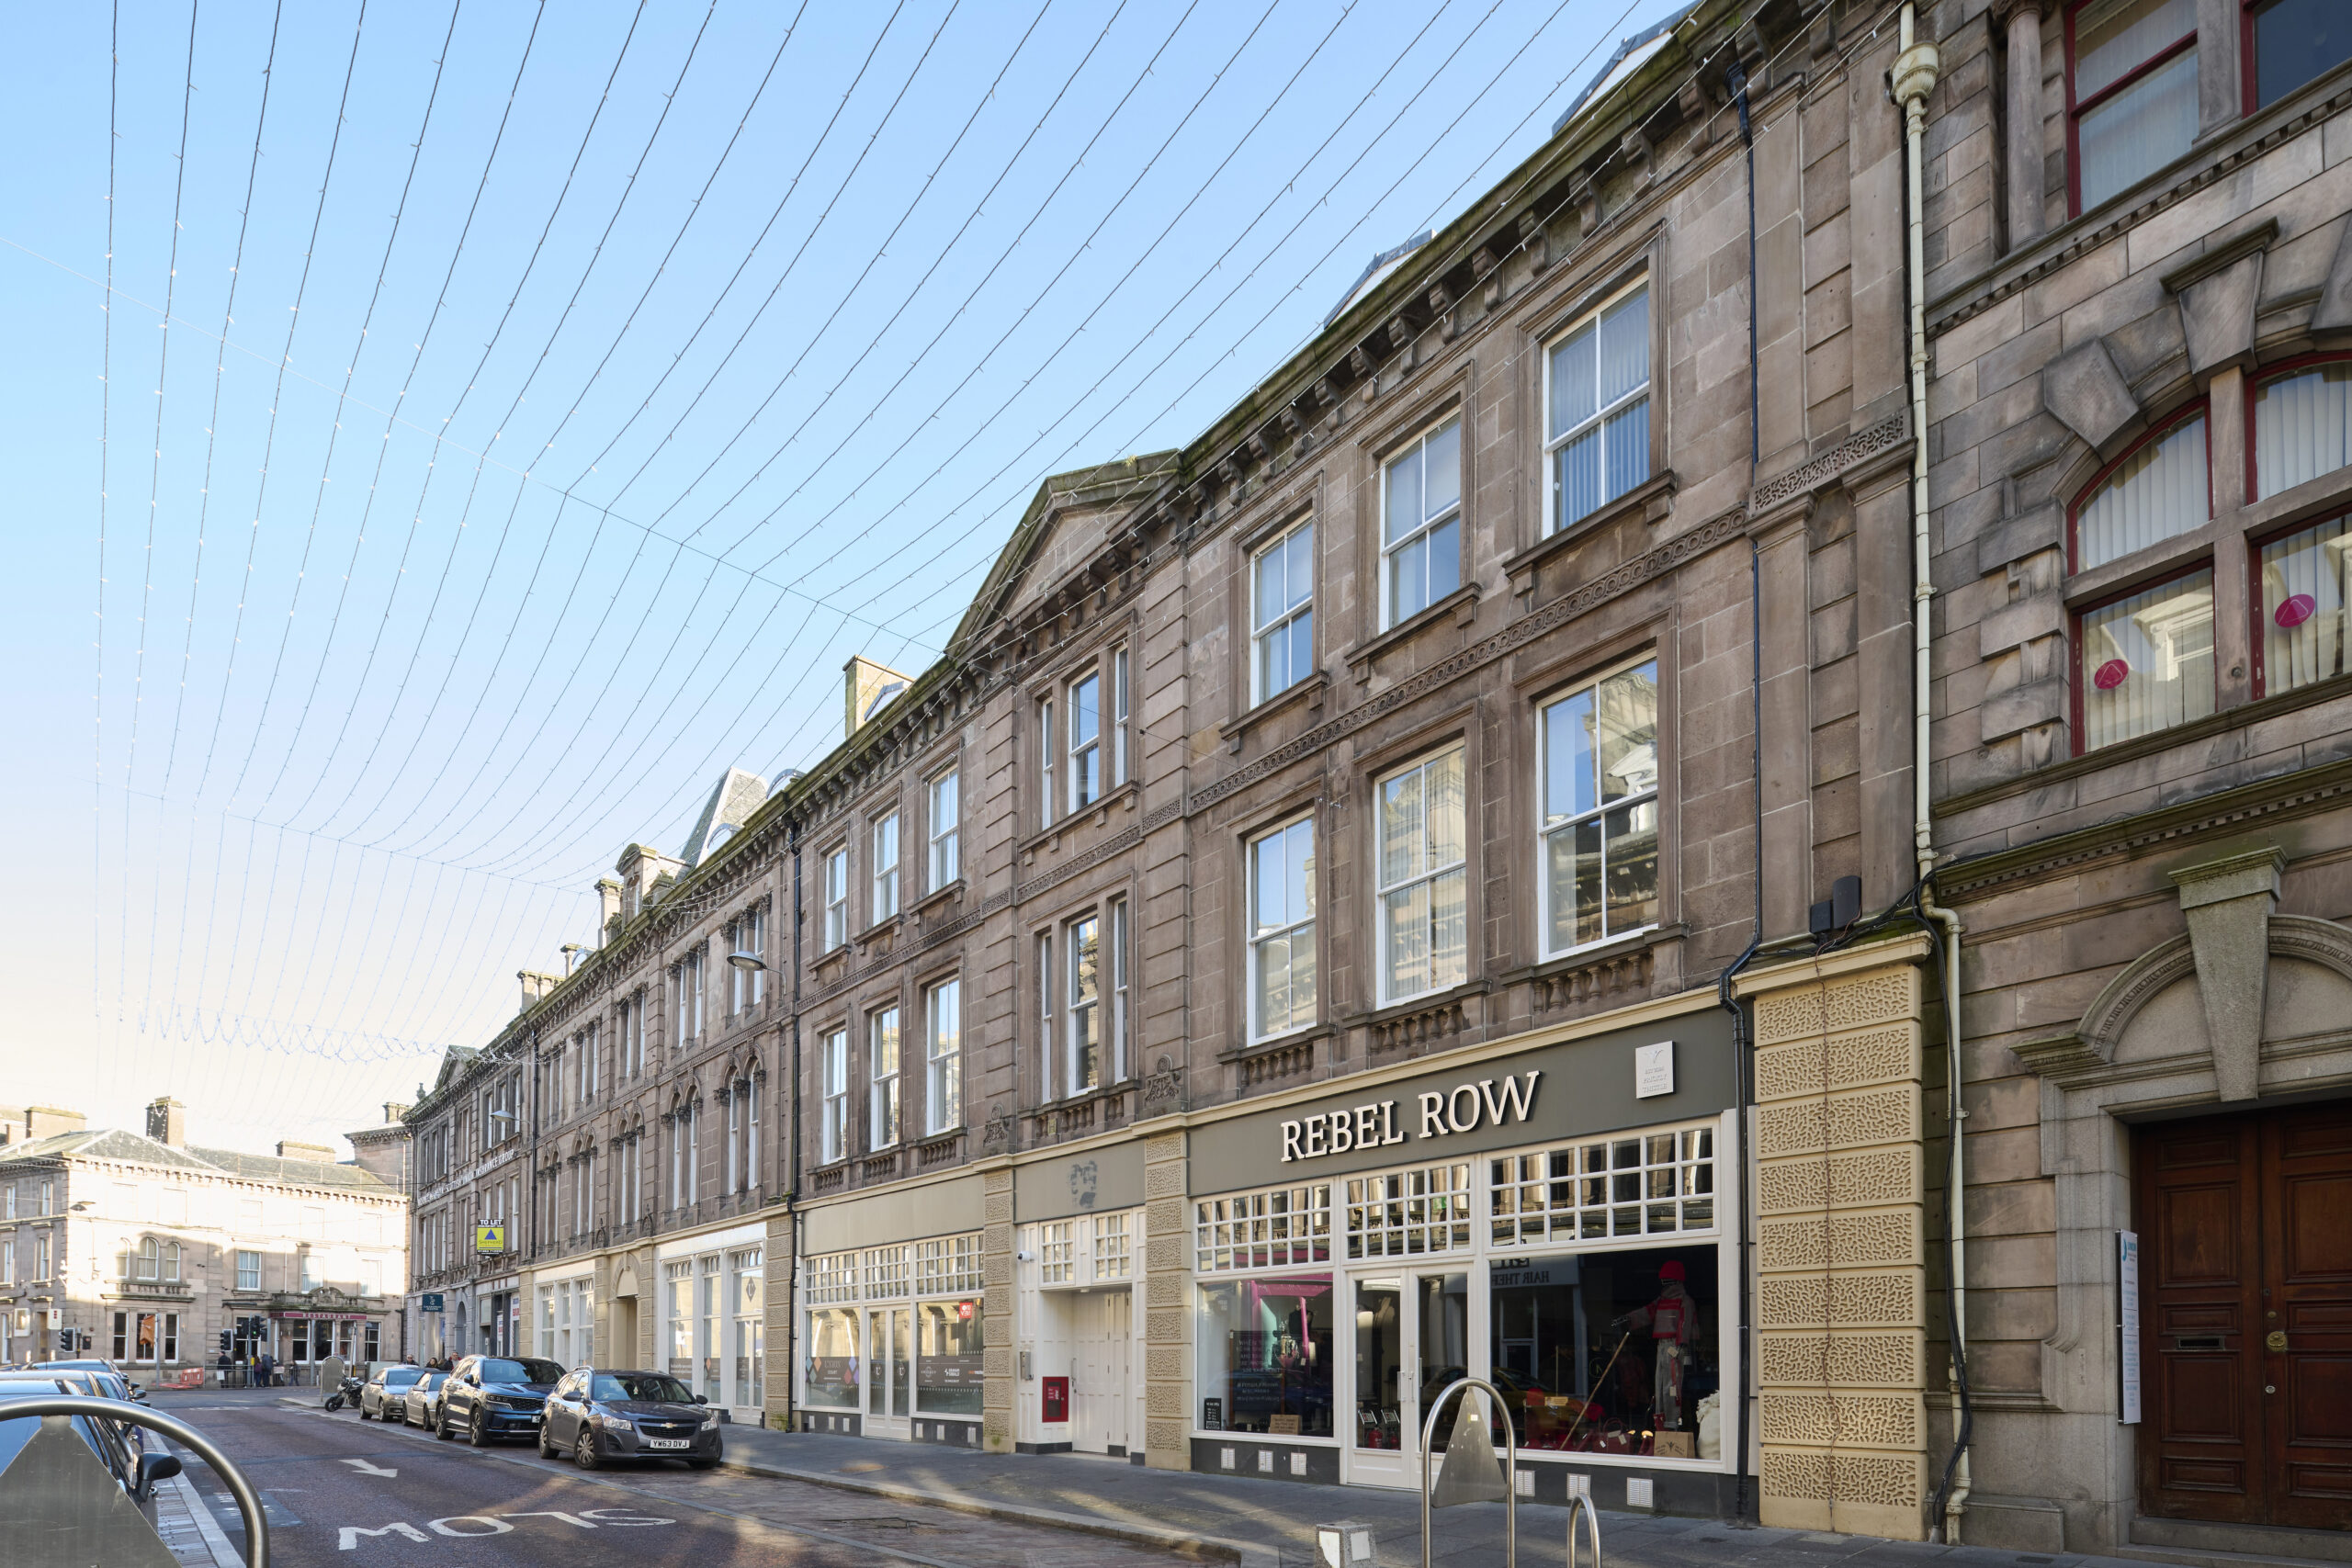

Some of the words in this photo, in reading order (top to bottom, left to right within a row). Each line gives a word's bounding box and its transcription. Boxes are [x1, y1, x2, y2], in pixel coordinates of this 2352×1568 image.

[1281, 1100, 1404, 1162] REBEL
[1419, 1070, 1540, 1138] ROW
[653, 1439, 672, 1448] YW63
[673, 1439, 687, 1448] DVJ
[338, 1508, 677, 1551] SLOW
